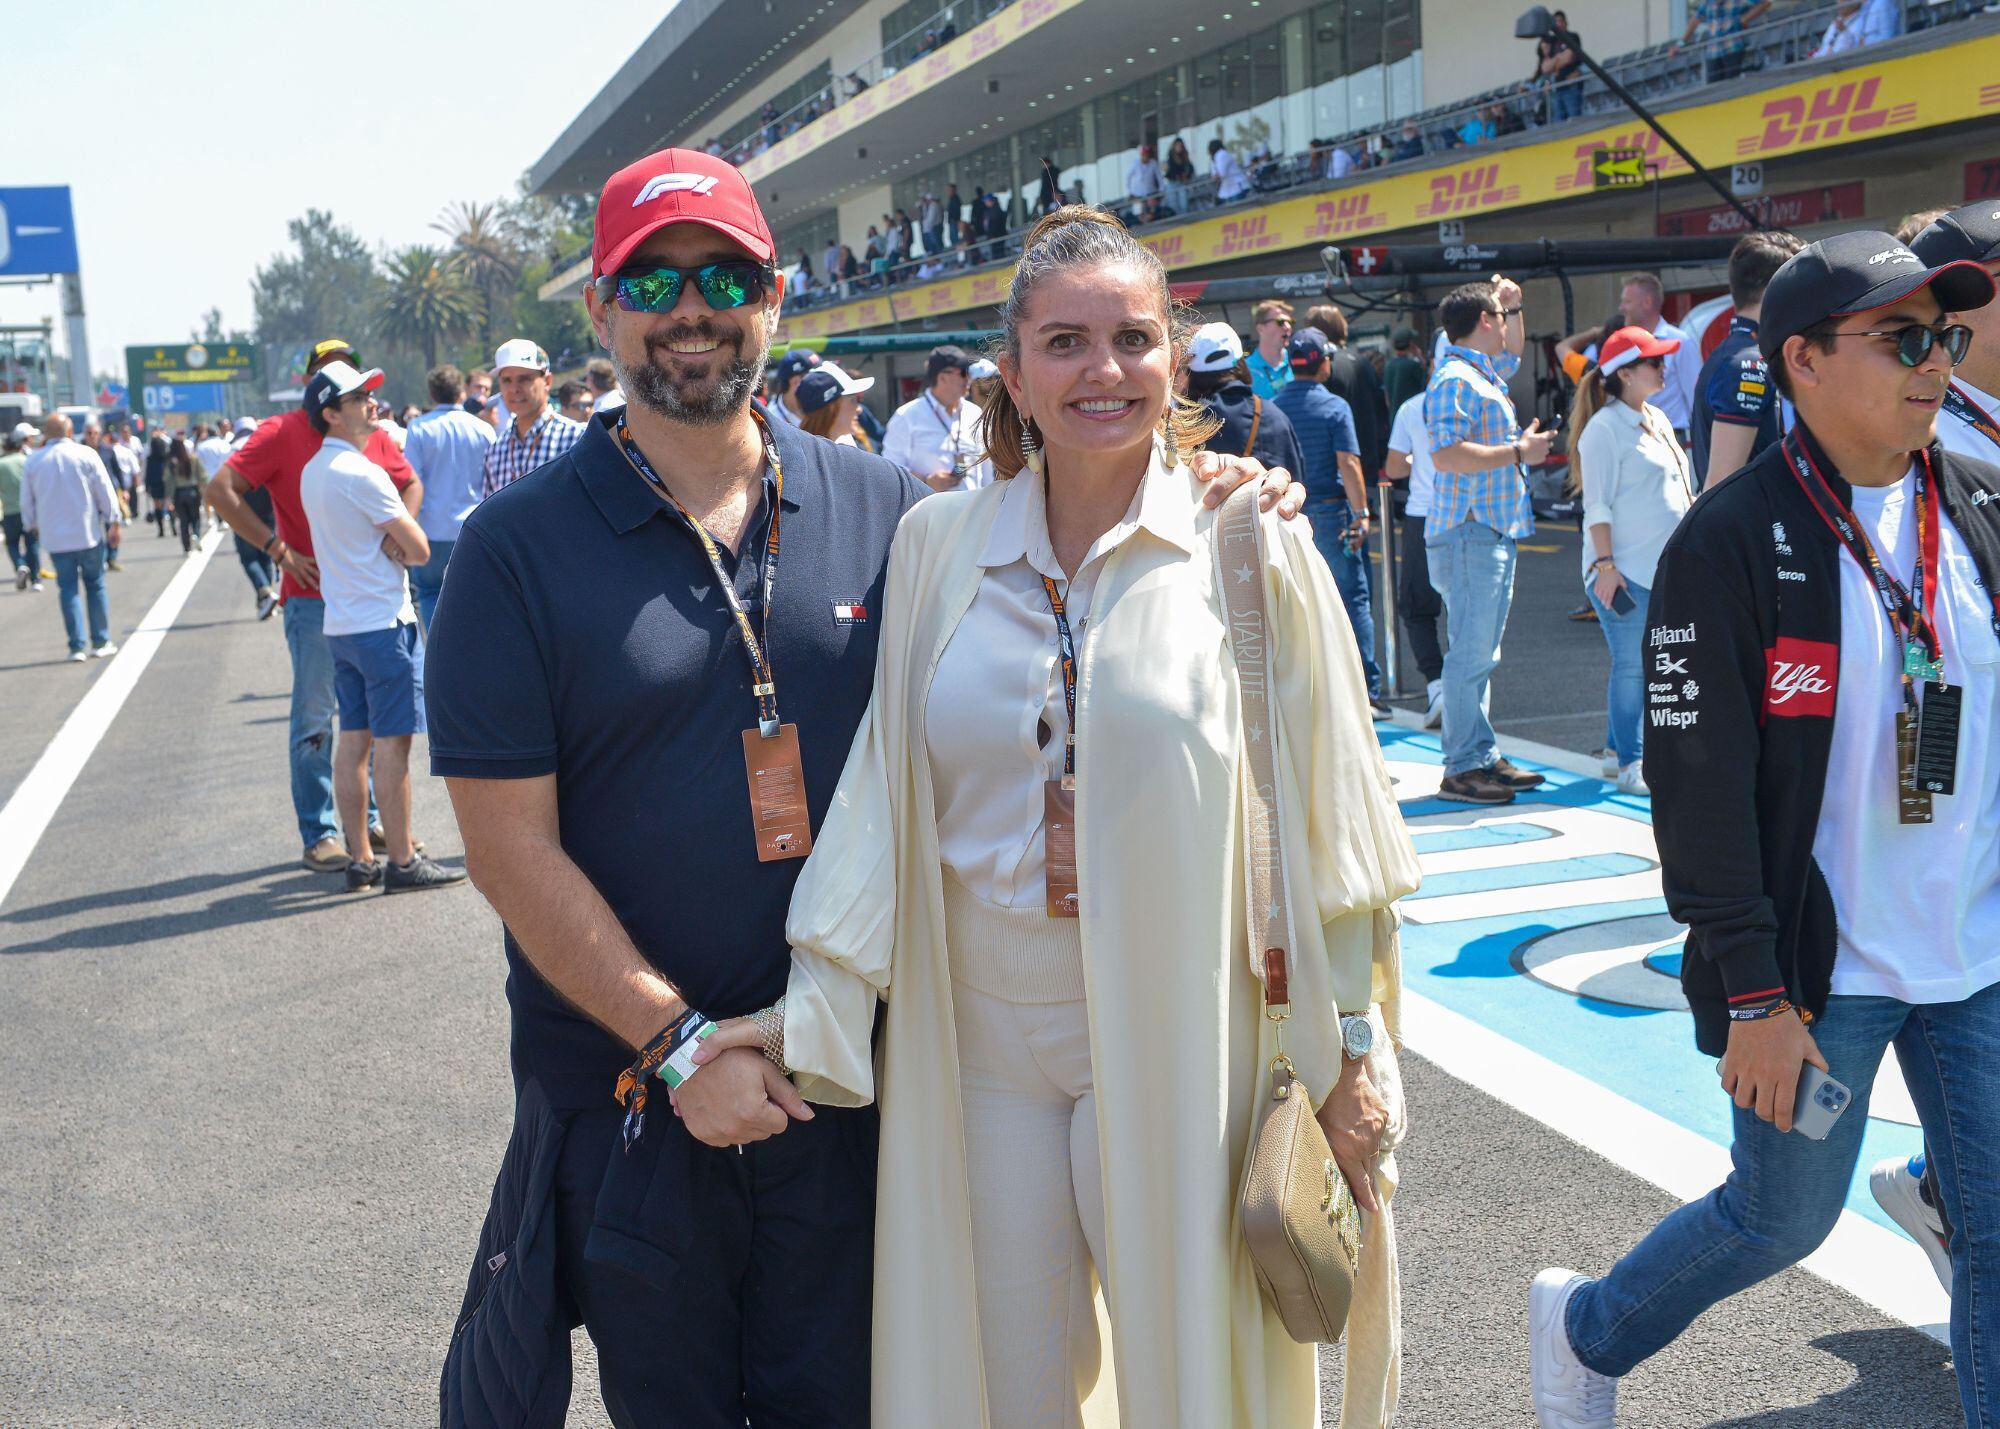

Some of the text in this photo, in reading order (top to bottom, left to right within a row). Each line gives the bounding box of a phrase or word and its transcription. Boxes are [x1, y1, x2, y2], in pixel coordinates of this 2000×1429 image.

[1760, 76, 1889, 150] DHL
[632, 173, 719, 207] F1
[1429, 164, 1505, 216] DHL
[1735, 167, 1760, 184] 20
[1982, 162, 2000, 194] 7
[1314, 194, 1376, 236] DHL
[1443, 222, 1462, 237] 21
[1222, 216, 1270, 254] DHL
[1232, 608, 1265, 703] STARLITE
[1648, 682, 1673, 693] Grupo
[1650, 707, 1699, 730] Wispr
[1252, 783, 1281, 878] STARLITE
